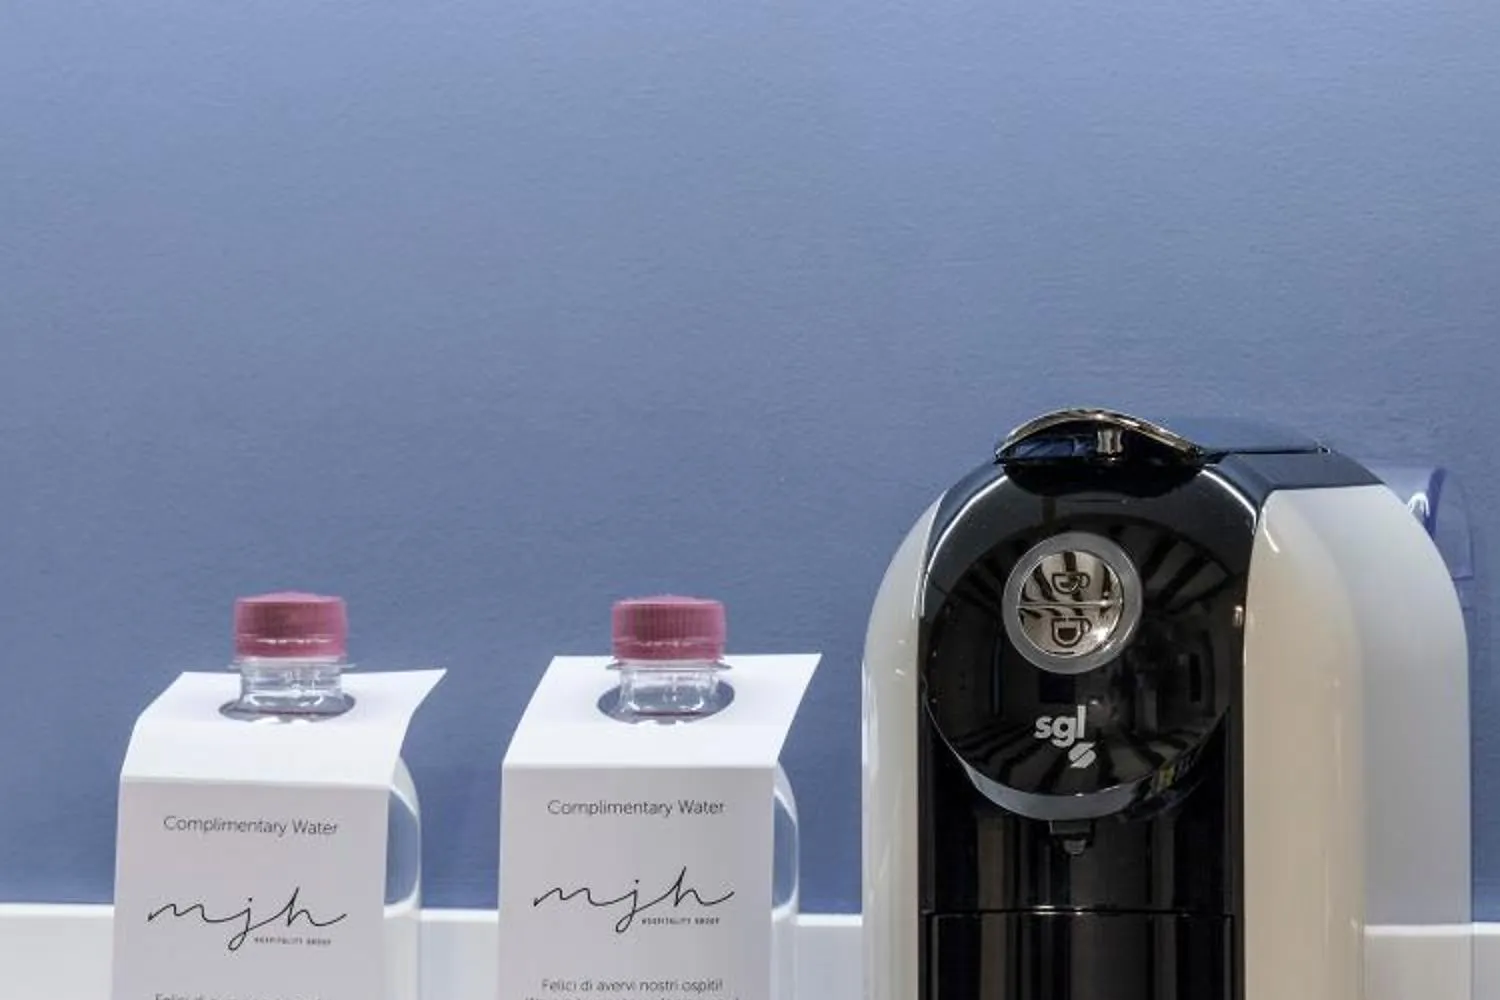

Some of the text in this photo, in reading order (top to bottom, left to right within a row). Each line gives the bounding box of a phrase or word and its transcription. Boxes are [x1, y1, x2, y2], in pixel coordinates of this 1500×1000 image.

[1033, 705, 1087, 748] sgl
[547, 800, 725, 818] Complimentary Water
[163, 815, 339, 838] Complimentary Water
[533, 866, 735, 933] mjh
[148, 886, 347, 950] mjh
[541, 979, 723, 994] Felici di avervi nostri ospiti!
